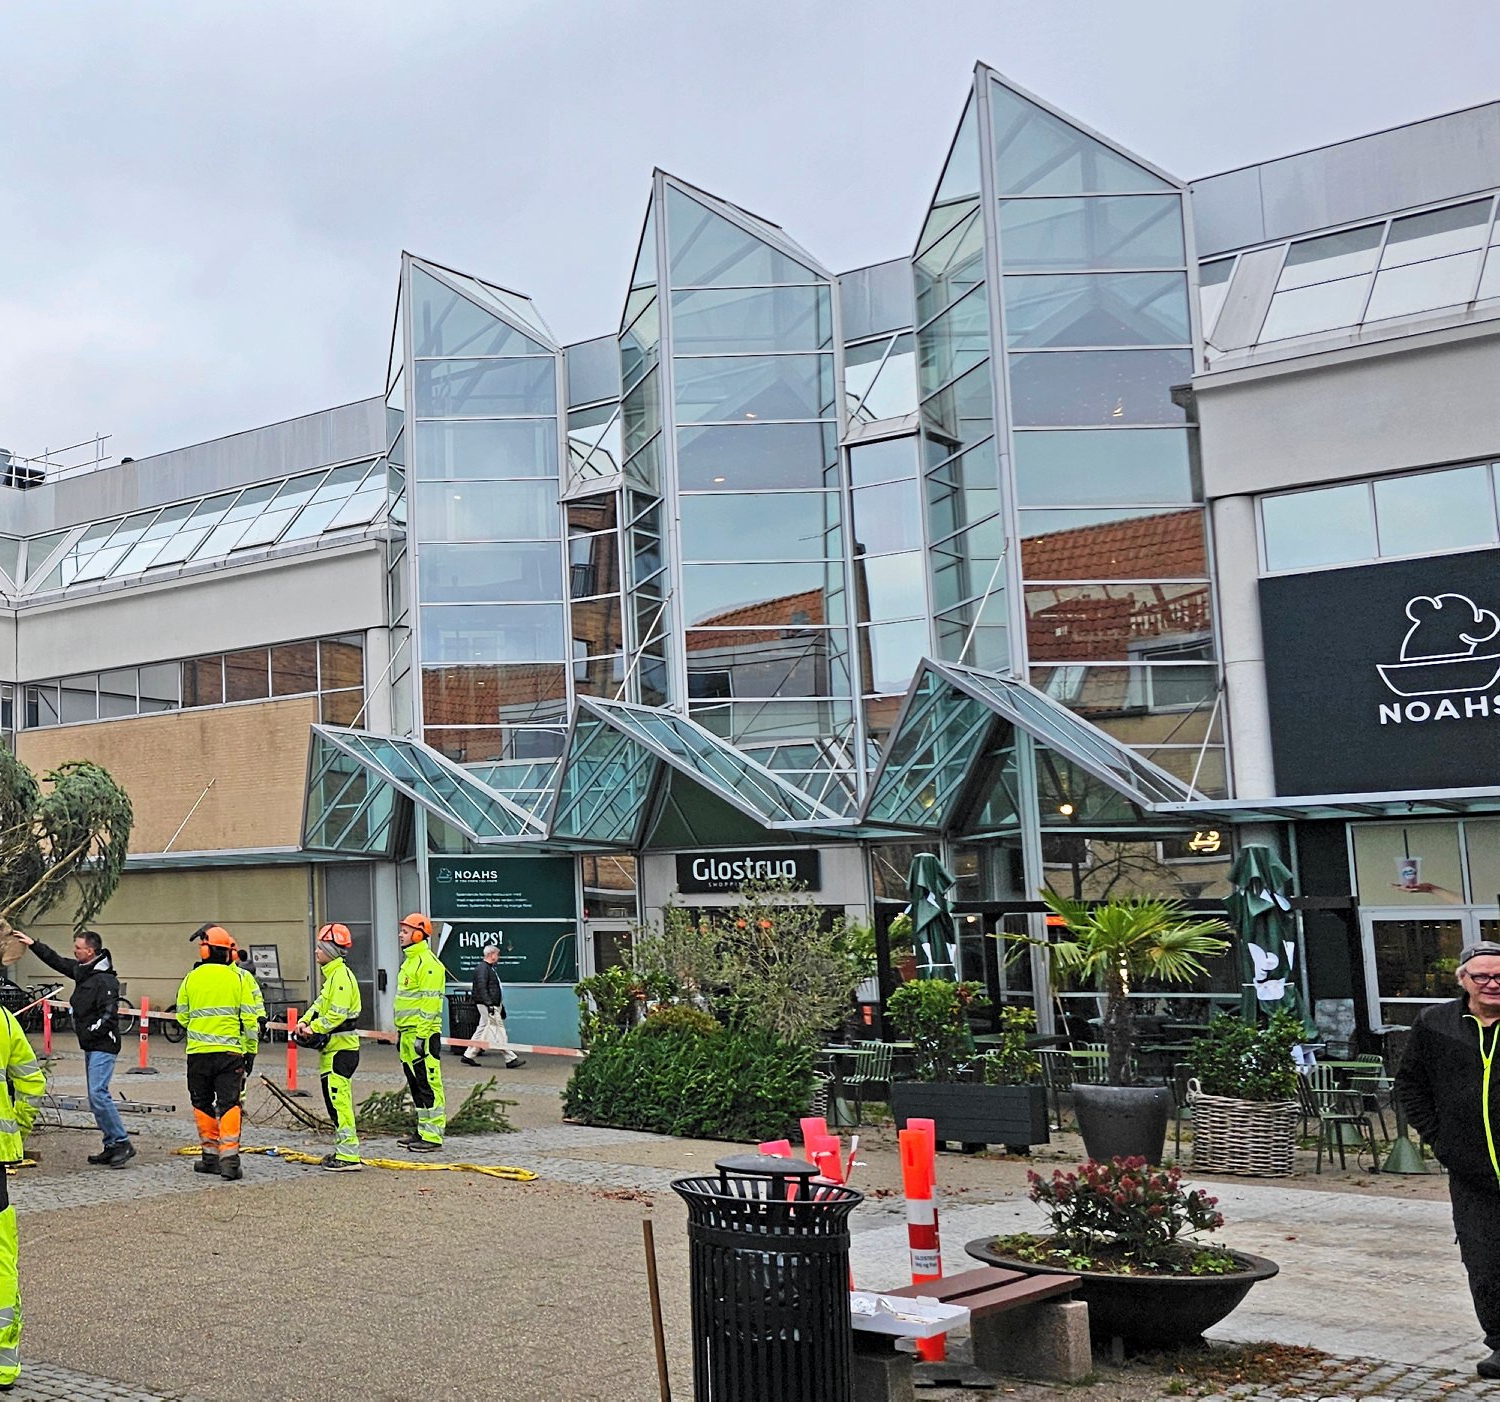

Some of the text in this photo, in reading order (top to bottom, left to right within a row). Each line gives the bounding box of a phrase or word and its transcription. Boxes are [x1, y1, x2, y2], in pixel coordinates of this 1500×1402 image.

[454, 870, 498, 879] NOAHS
[692, 857, 796, 880] Glostrup
[459, 931, 503, 948] HAPS!
